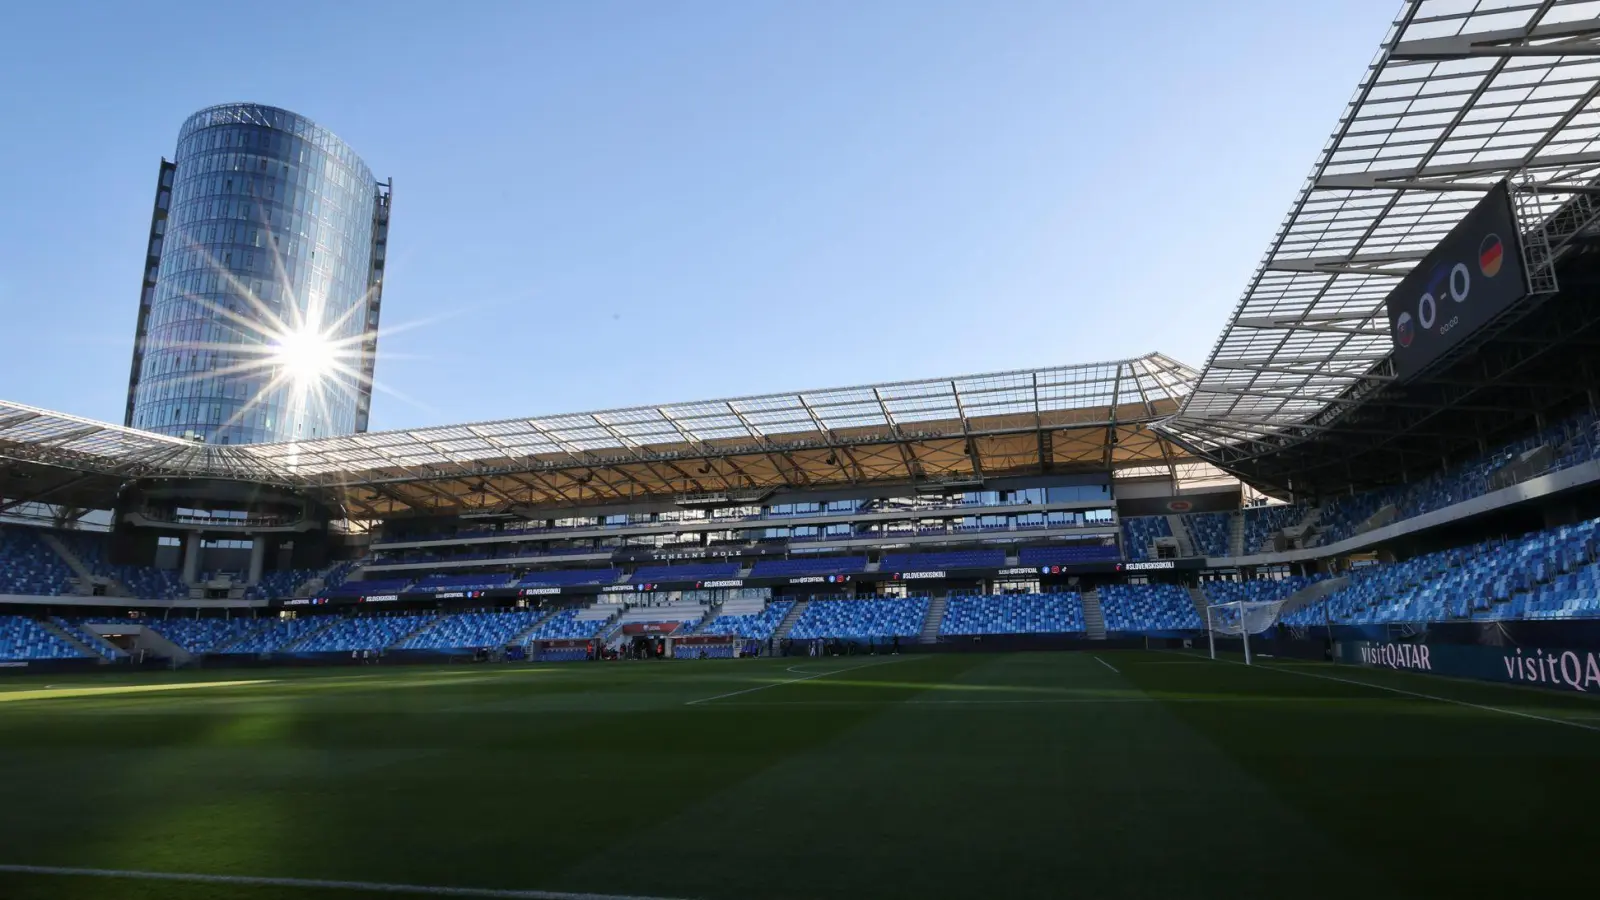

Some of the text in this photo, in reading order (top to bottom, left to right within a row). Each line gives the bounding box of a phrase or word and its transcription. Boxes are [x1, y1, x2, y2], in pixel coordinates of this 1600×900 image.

[653, 550, 742, 560] TEHELNÉ POLE
[1125, 561, 1175, 570] #SLOVENSKISOKOLI
[902, 571, 946, 579] #SLOVENSKISOKOLI
[704, 579, 743, 588] #SLOVENSKISOKOLI
[1361, 641, 1432, 670] visitQATAR
[1504, 648, 1600, 692] visitQA
